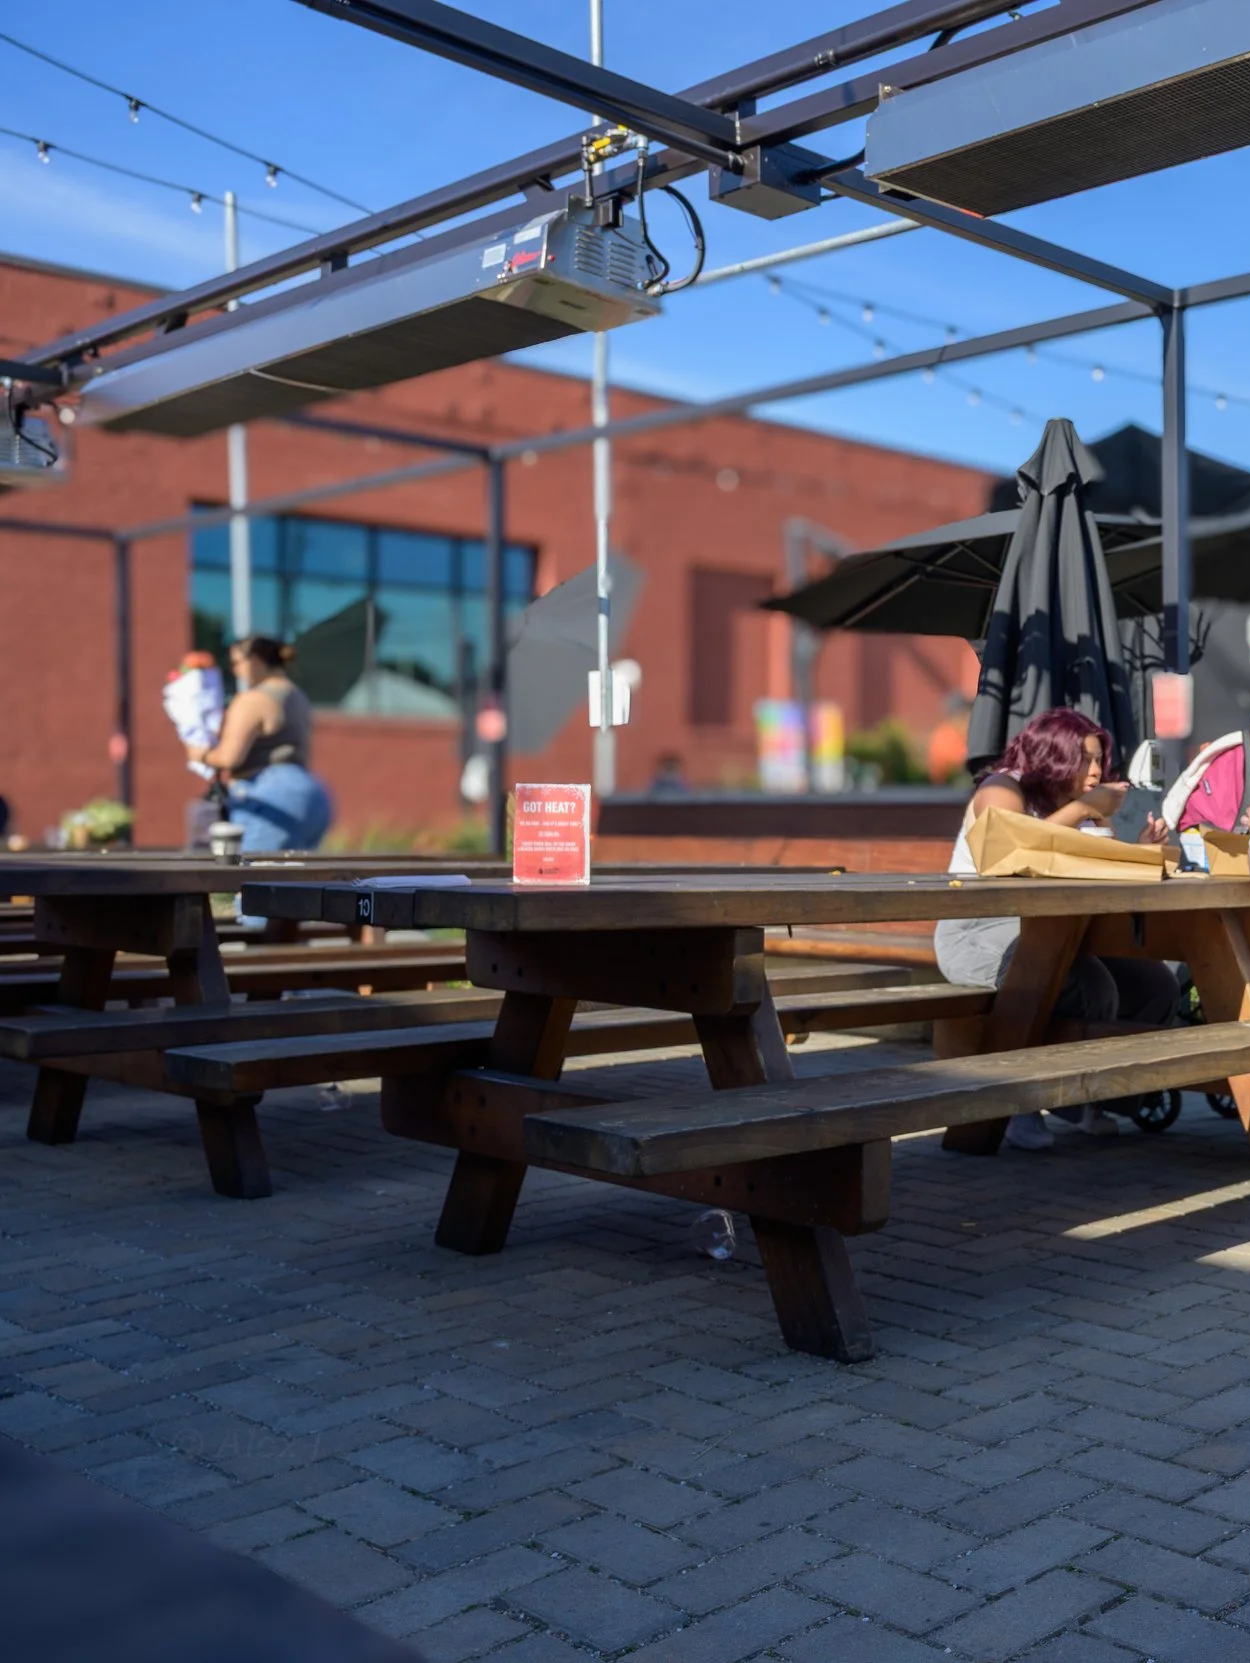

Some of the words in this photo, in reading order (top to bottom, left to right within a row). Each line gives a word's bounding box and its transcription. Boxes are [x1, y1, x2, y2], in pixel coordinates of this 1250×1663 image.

[523, 801, 543, 813] GOT
[545, 801, 576, 814] HEAT?
[358, 899, 371, 917] 10
